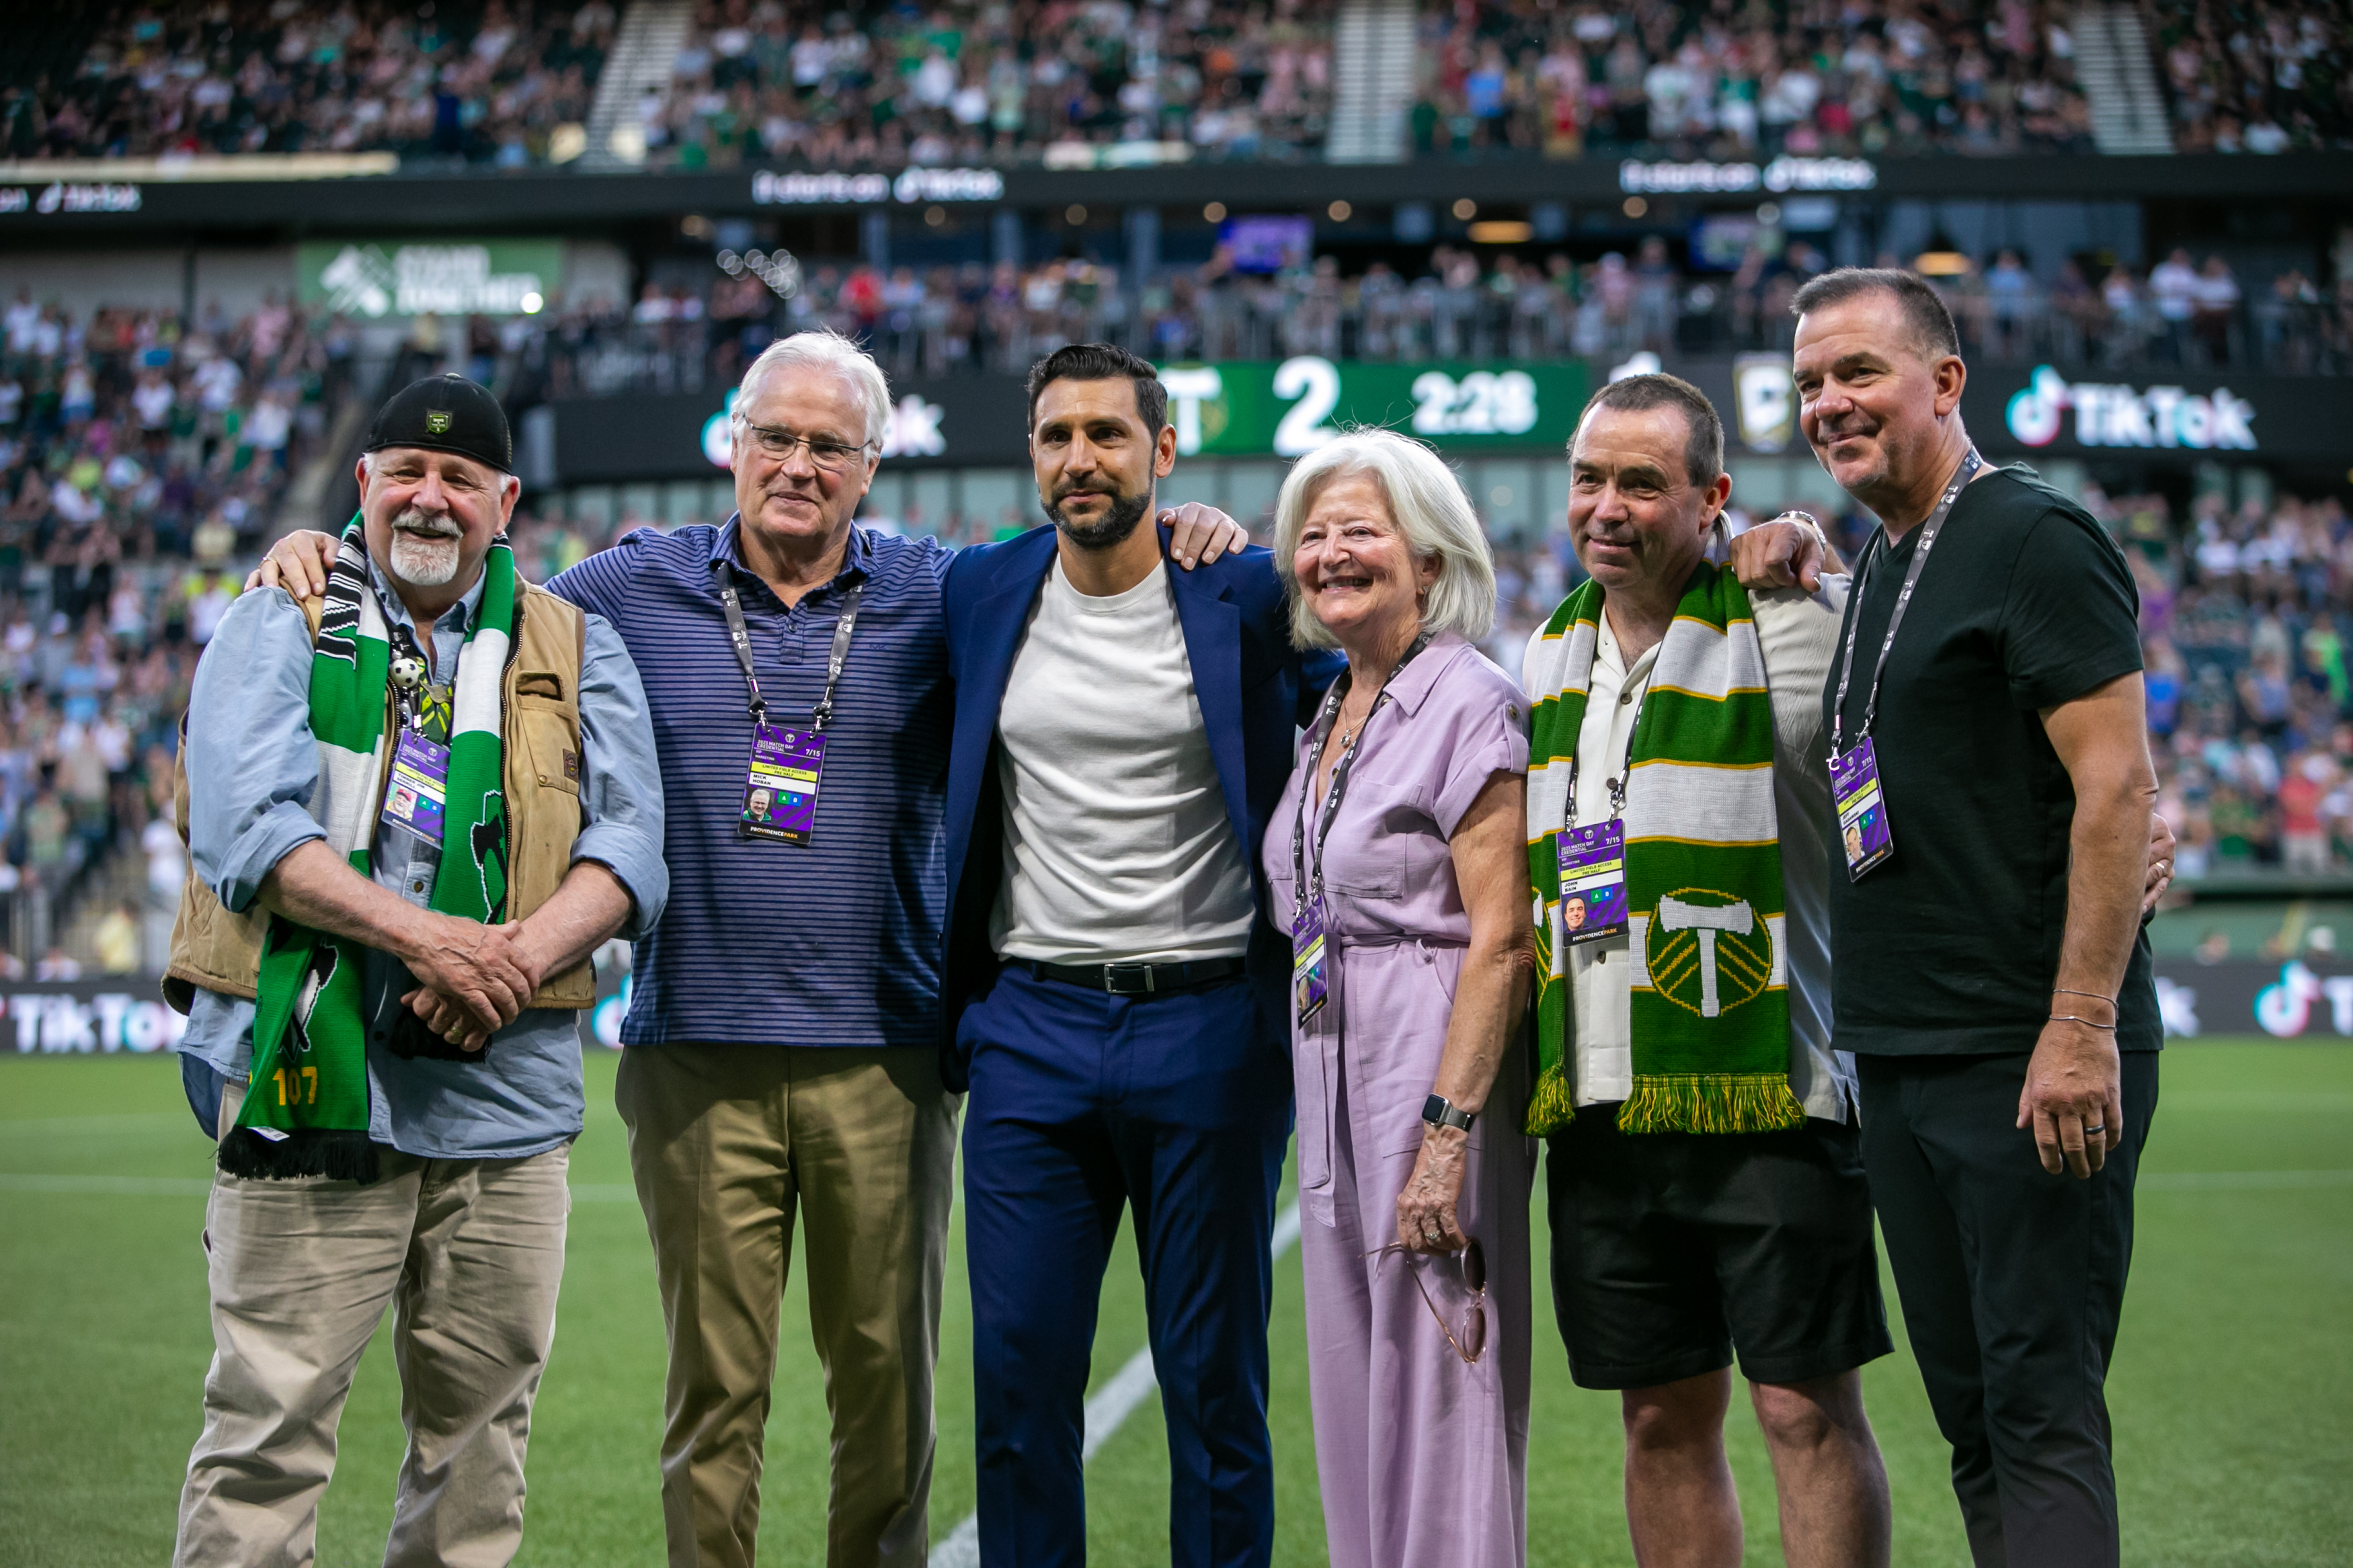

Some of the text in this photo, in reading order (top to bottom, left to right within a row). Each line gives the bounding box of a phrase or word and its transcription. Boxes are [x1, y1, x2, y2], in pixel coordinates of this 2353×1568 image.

[1272, 356, 1341, 456] 2
[2072, 382, 2259, 450] TikTok
[757, 743, 785, 752] CREDENTIAL
[805, 749, 821, 757] 7/15
[398, 772, 415, 784] TIMBER
[1605, 836, 1620, 845] 7/15
[1561, 847, 1587, 856] CREDENTIAL
[272, 1066, 317, 1106] 107
